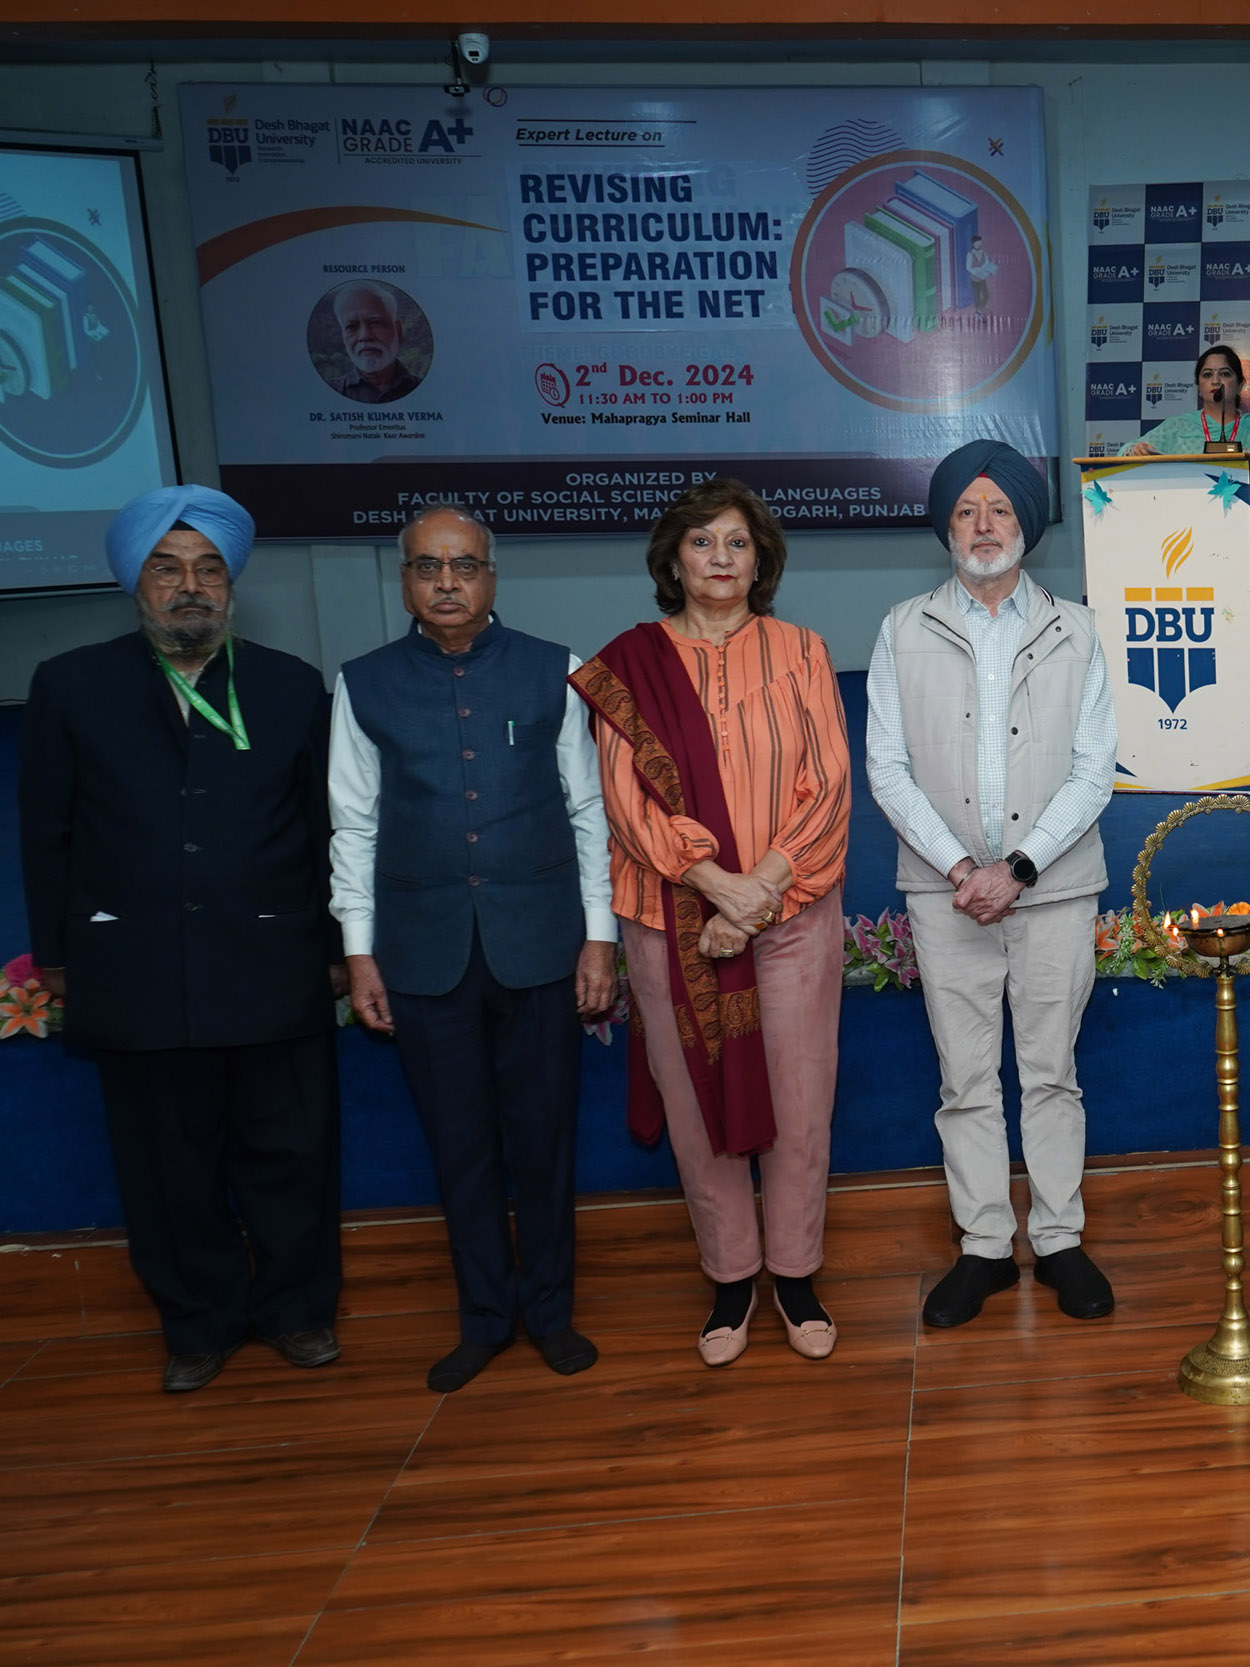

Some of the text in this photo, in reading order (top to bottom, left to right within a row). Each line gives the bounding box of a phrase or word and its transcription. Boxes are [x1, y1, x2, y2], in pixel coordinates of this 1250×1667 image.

[255, 119, 330, 134] Desh Bhagat
[341, 118, 412, 136] NAAC
[208, 128, 248, 144] DBU
[256, 133, 316, 148] University
[418, 118, 474, 153] A+
[516, 128, 662, 143] Expert Lecture on
[343, 137, 413, 153] GRADE
[365, 157, 462, 165] ACCREDITED UNIVERSITY
[520, 173, 693, 204] REVISING
[1094, 211, 1110, 219] DBU
[1150, 205, 1175, 213] NAAC
[1176, 204, 1197, 218] A+
[1207, 208, 1224, 216] DBU
[523, 212, 782, 243] CURRICULUM:
[322, 264, 406, 273] RESOURCE PERSON
[526, 251, 778, 282] PREPARATION
[1118, 265, 1139, 278] A+
[529, 289, 765, 320] FOR THE NET
[1148, 323, 1172, 331] NAAC
[1173, 323, 1195, 336] A+
[618, 364, 674, 387] Dec.
[685, 364, 754, 386] 2024
[1115, 382, 1136, 395] A+
[1147, 386, 1163, 394] DBU
[579, 392, 733, 405] 11:30 AM TO 1:00 PM
[309, 412, 443, 422] DR. SATISH KUMAR VERMA
[541, 411, 751, 426] Venue: Mahapragya Seminar Hall
[565, 471, 717, 486] ORGANIZED BY
[397, 491, 490, 505] FACULTY
[496, 491, 524, 505] OF
[531, 489, 605, 504] SOCIAL
[761, 487, 881, 501] LANGUAGES
[353, 510, 406, 524] DESH
[504, 507, 628, 523] UNIVERSITY,
[849, 503, 926, 518] PUNJAB
[1124, 607, 1215, 643] DBU
[1157, 718, 1188, 730] 1972
